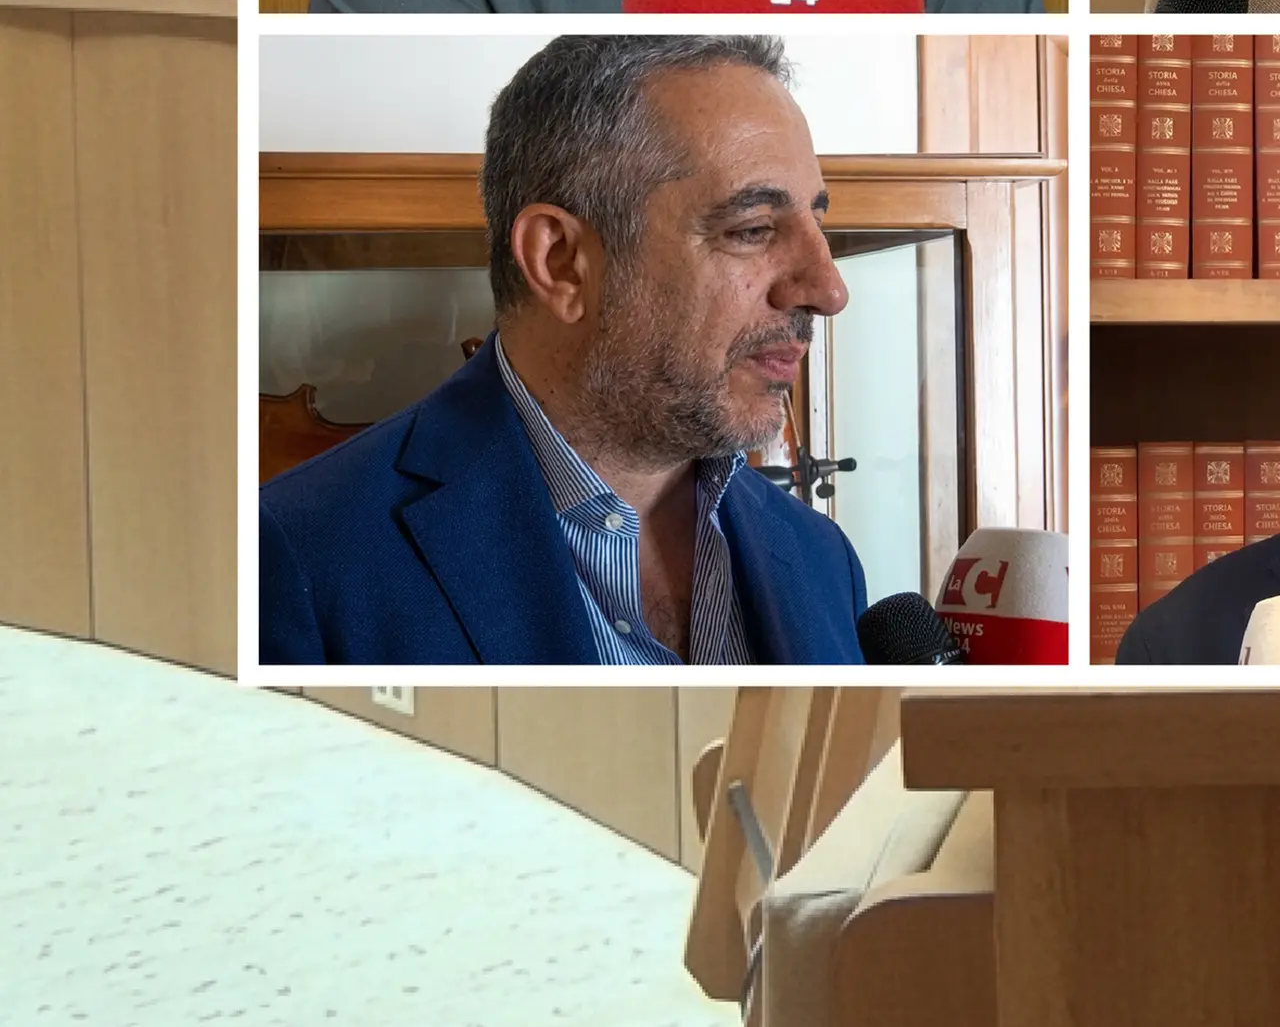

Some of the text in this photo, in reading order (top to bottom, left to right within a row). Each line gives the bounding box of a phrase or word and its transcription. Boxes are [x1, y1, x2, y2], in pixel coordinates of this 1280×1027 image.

[1096, 67, 1126, 76] STORIA
[1148, 71, 1178, 80] STORIA
[1208, 71, 1238, 80] STORIA
[1096, 85, 1126, 93] CHIESA
[1148, 89, 1178, 97] CHIESA
[1097, 507, 1127, 516] STORIA
[1203, 503, 1233, 512] STORIA
[1097, 525, 1127, 533] CHIESA
[1203, 522, 1233, 531] CHIESA
[943, 616, 984, 636] News
